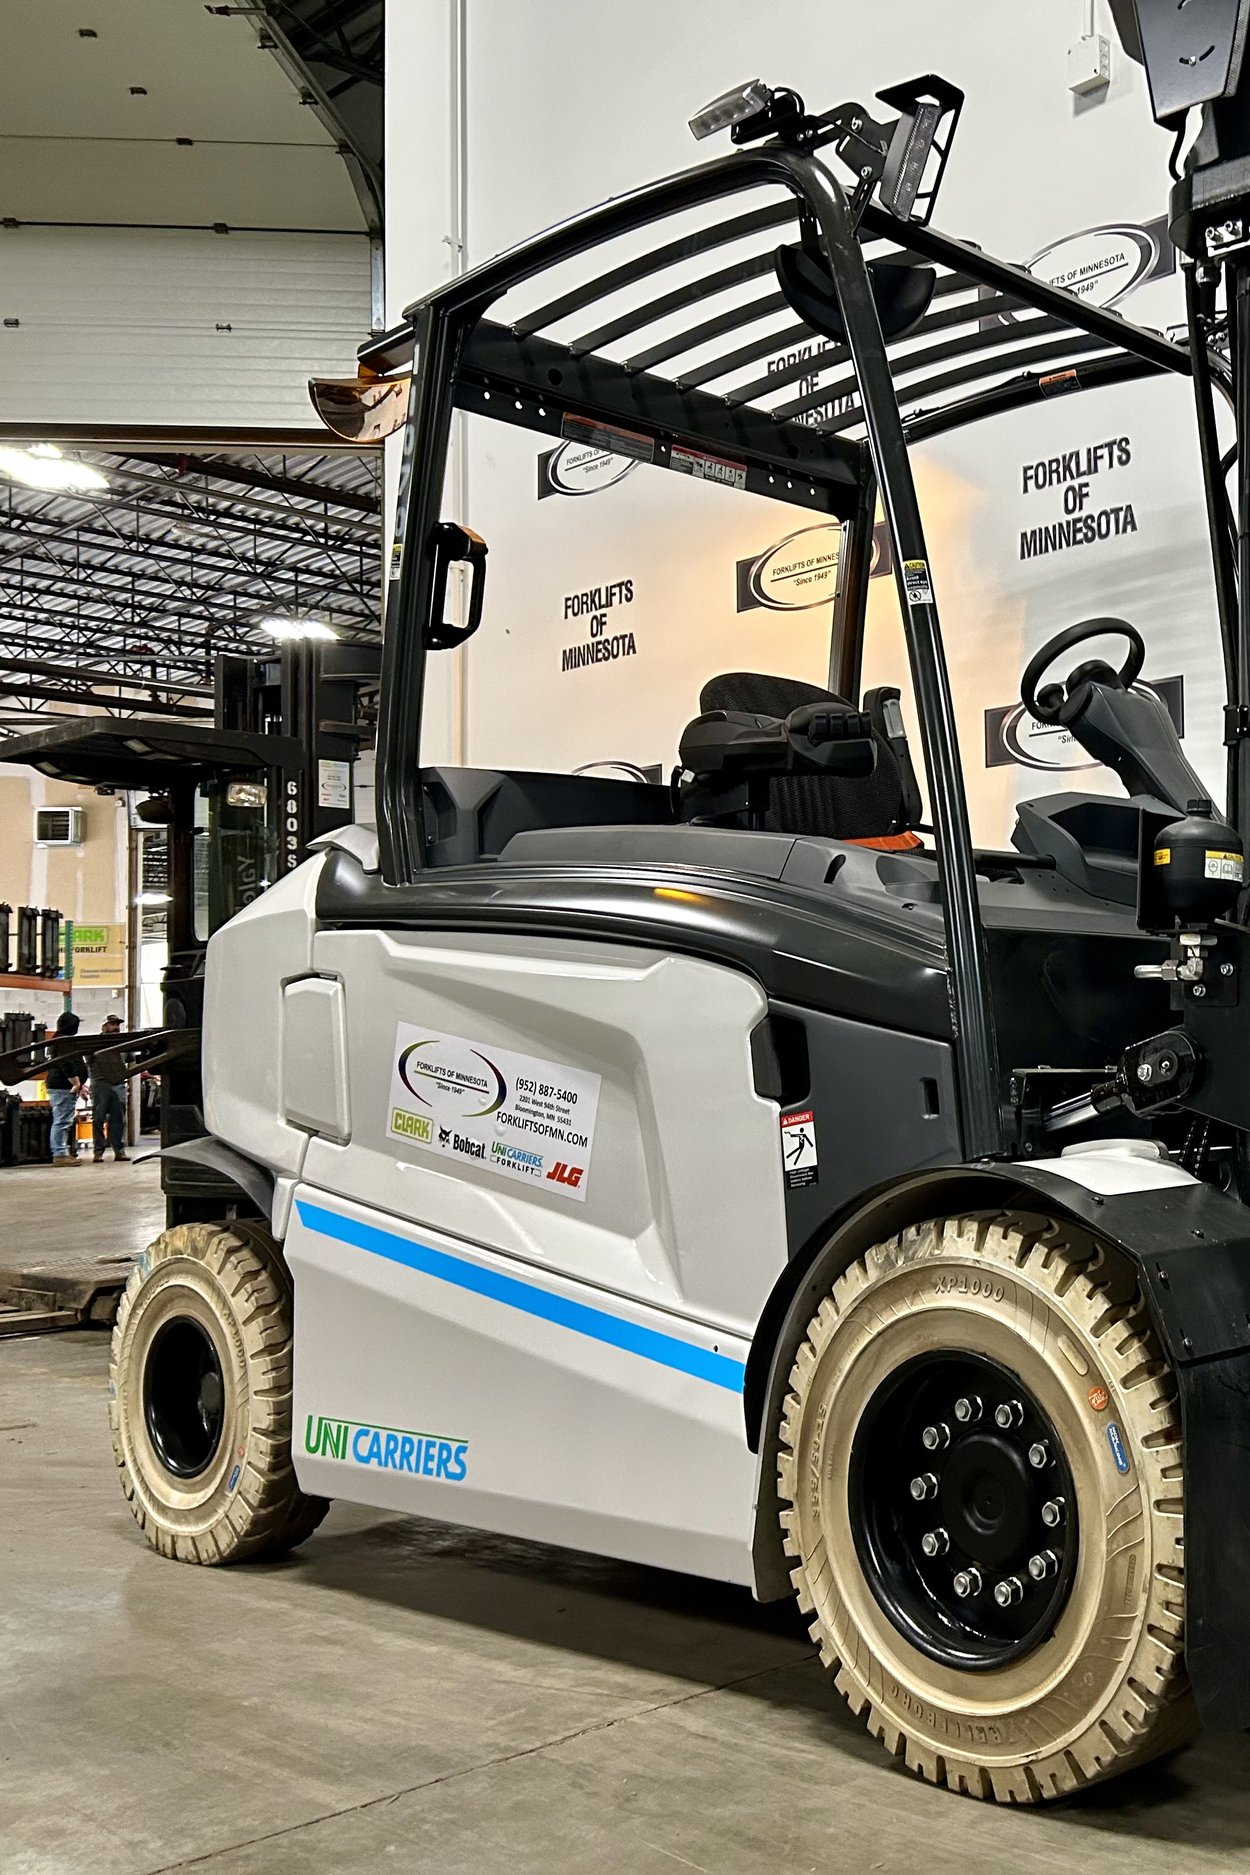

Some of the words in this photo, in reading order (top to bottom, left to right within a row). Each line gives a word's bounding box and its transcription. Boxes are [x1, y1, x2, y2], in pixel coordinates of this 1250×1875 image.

[1079, 253, 1126, 277] MINNESOTA
[1022, 437, 1132, 494] FORKLIFTS
[1063, 482, 1090, 515] OF
[1020, 504, 1138, 560] MINNESOTA
[772, 561, 806, 576] FORKLIFTS
[806, 559, 815, 567] OF
[816, 552, 840, 565] MINNES
[564, 579, 634, 620] FORKLIFTS
[590, 613, 607, 638] OF
[562, 632, 637, 672] MINNESOTA
[416, 1061, 447, 1076] FORKLIFTS
[447, 1069, 455, 1078] OF
[455, 1072, 488, 1088] MINNESOTA
[515, 1077, 537, 1096] (952)
[538, 1083, 578, 1105] 887-5400
[531, 1098, 543, 1108] West
[555, 1104, 570, 1116] Street
[546, 1112, 556, 1122] MN
[789, 1114, 810, 1124] DANGER
[394, 1112, 430, 1140] CLARK
[496, 1111, 588, 1148] FORKLIFTSOFMN.COM
[496, 1156, 535, 1175] FORKLIFT
[546, 1161, 584, 1188] JLG
[935, 1275, 1005, 1303] XP1000
